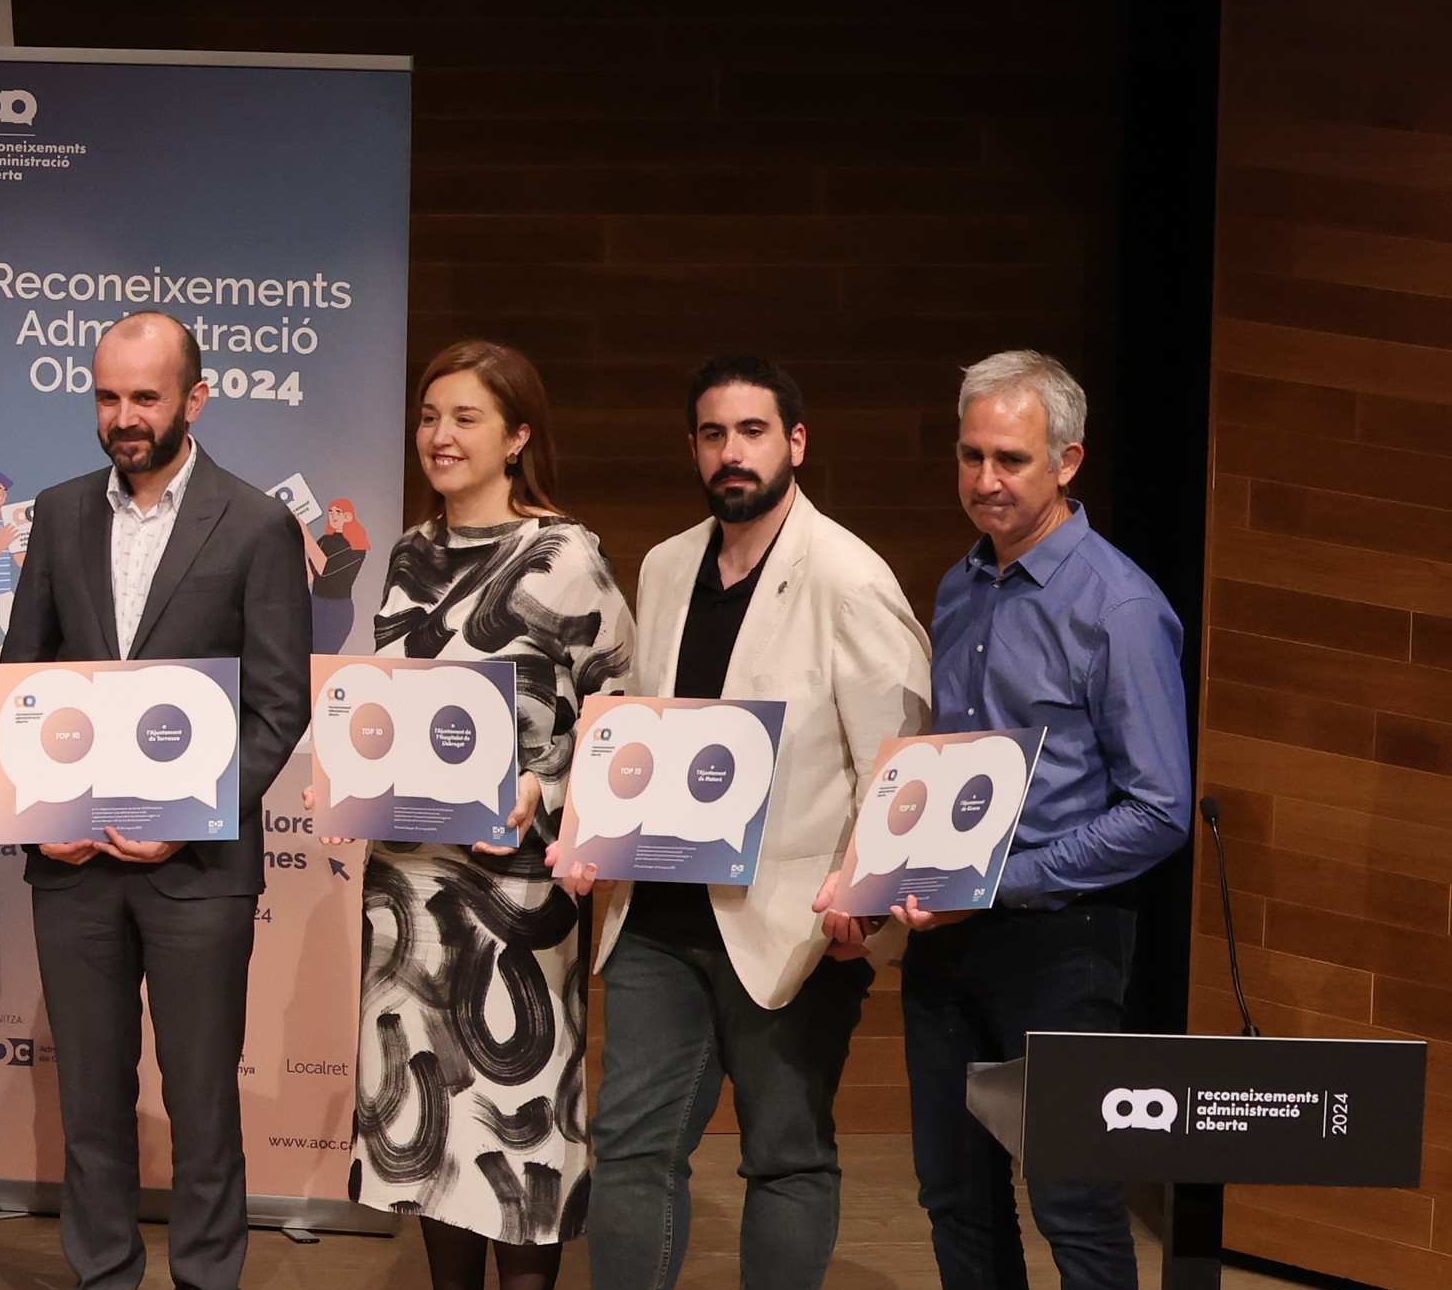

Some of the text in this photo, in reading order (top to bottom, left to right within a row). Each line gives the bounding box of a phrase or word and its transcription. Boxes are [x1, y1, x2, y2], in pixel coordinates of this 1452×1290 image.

[16, 309, 319, 355] Admtració
[286, 1058, 349, 1076] Localret
[1197, 1088, 1320, 1104] reconeixements
[1196, 1103, 1301, 1119] administració
[1331, 1092, 1349, 1135] 2024
[1196, 1117, 1248, 1132] oberta
[268, 1136, 352, 1151] www.aoc.c
